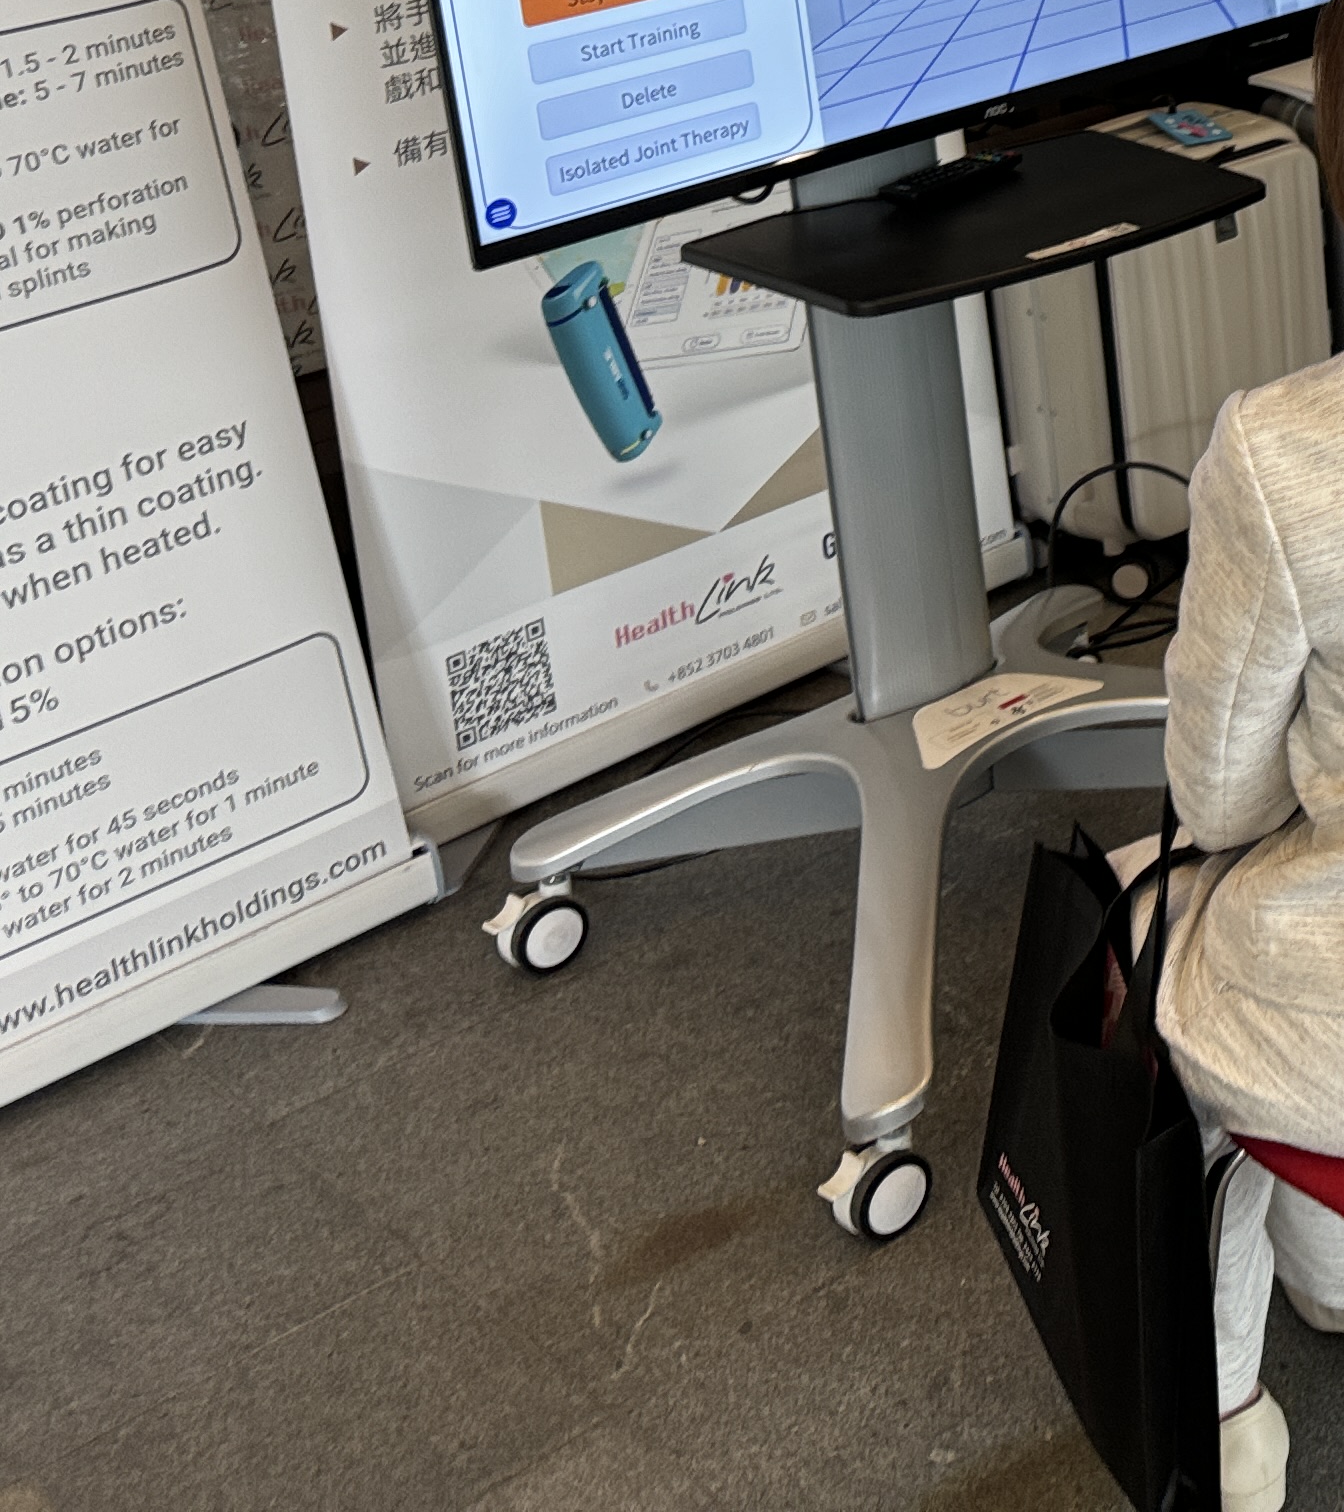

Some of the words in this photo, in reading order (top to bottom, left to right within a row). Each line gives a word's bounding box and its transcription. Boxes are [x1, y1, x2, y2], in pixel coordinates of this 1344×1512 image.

[63, 43, 80, 67] 2
[85, 22, 177, 59] minutes
[580, 38, 625, 63] Start
[627, 20, 701, 50] Training
[34, 80, 51, 103] 5
[70, 70, 86, 94] 7
[95, 49, 185, 89] minutes
[621, 82, 678, 110] Delete
[6, 142, 71, 177] 70°C
[75, 124, 143, 161] water
[149, 116, 181, 144] for
[392, 129, 450, 168] 備有
[559, 149, 630, 184] Isolated
[632, 140, 678, 163] Joint
[680, 118, 750, 151] Therapy
[13, 209, 51, 236] 1%
[57, 173, 189, 230] perforation
[24, 238, 60, 267] for
[67, 213, 157, 252] making
[8, 259, 93, 300] splints
[120, 446, 168, 483] for
[178, 419, 248, 462] easy
[35, 531, 55, 555] a
[62, 502, 129, 544] thin
[137, 459, 263, 519] coating.
[1, 560, 94, 610] when
[99, 510, 222, 576] heated.
[54, 597, 187, 665] options:
[668, 657, 703, 683] +852
[706, 640, 740, 669] 3703
[743, 626, 775, 652] 4801
[0, 686, 60, 728] 5%
[414, 763, 453, 793] Scan
[456, 753, 480, 776] for
[484, 735, 525, 763] more
[528, 695, 619, 746] information
[3, 747, 103, 804] minutes
[12, 771, 112, 829] minutes
[17, 878, 44, 906] to
[49, 849, 110, 884] 70°C
[114, 817, 181, 860] water
[184, 800, 219, 835] for
[225, 794, 238, 814] 1
[244, 758, 321, 808] minute
[65, 820, 100, 859] for
[106, 807, 138, 837] 45
[143, 766, 241, 821] seconds
[2, 895, 73, 940] water
[78, 876, 113, 910] for
[119, 866, 137, 890] 2
[140, 825, 235, 880] minutes
[0, 838, 389, 1036] ww.healthlinkholdings.com
